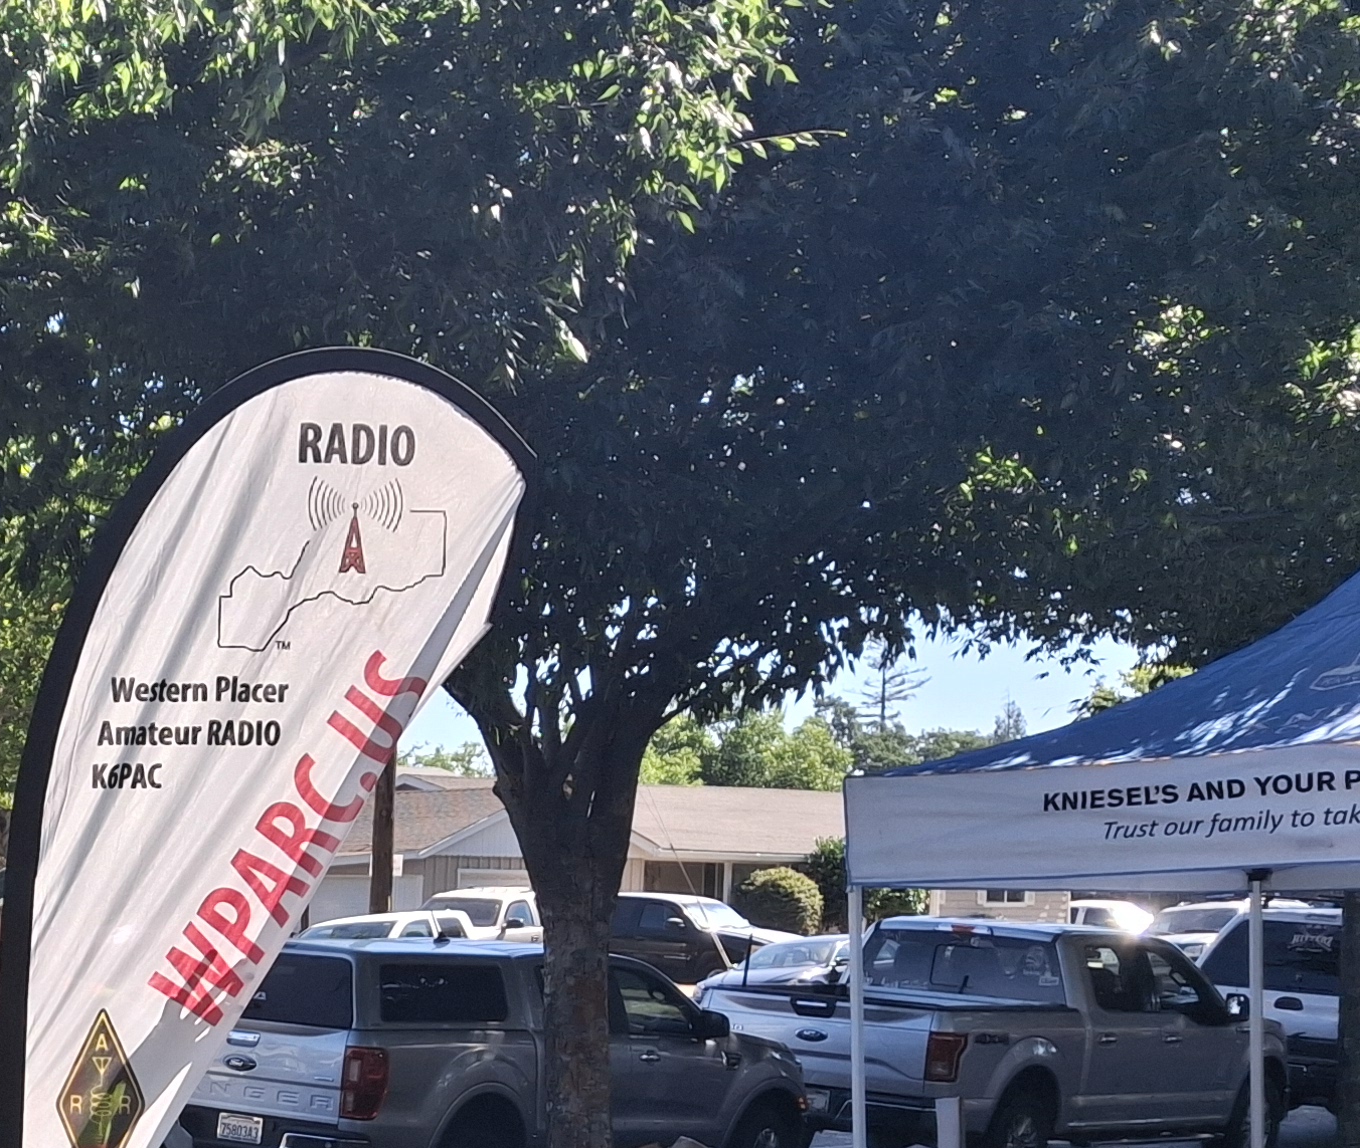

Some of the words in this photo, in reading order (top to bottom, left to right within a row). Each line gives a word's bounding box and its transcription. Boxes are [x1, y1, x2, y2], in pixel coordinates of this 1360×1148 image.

[298, 422, 416, 466] RADIO
[275, 641, 291, 651] TM
[111, 676, 208, 703] Western
[216, 675, 289, 703] Placer
[97, 720, 202, 746] Amateur
[207, 719, 281, 746] RADIO
[92, 763, 162, 789] K6PAC
[1043, 784, 1179, 812] KNIESEL'S
[1186, 778, 1246, 802] AND
[1253, 771, 1336, 796] YOUR
[147, 649, 427, 1026] WPARC.US
[1104, 820, 1159, 840] Trust
[1163, 820, 1204, 837] our
[1205, 809, 1284, 838] family
[1291, 810, 1315, 828] to
